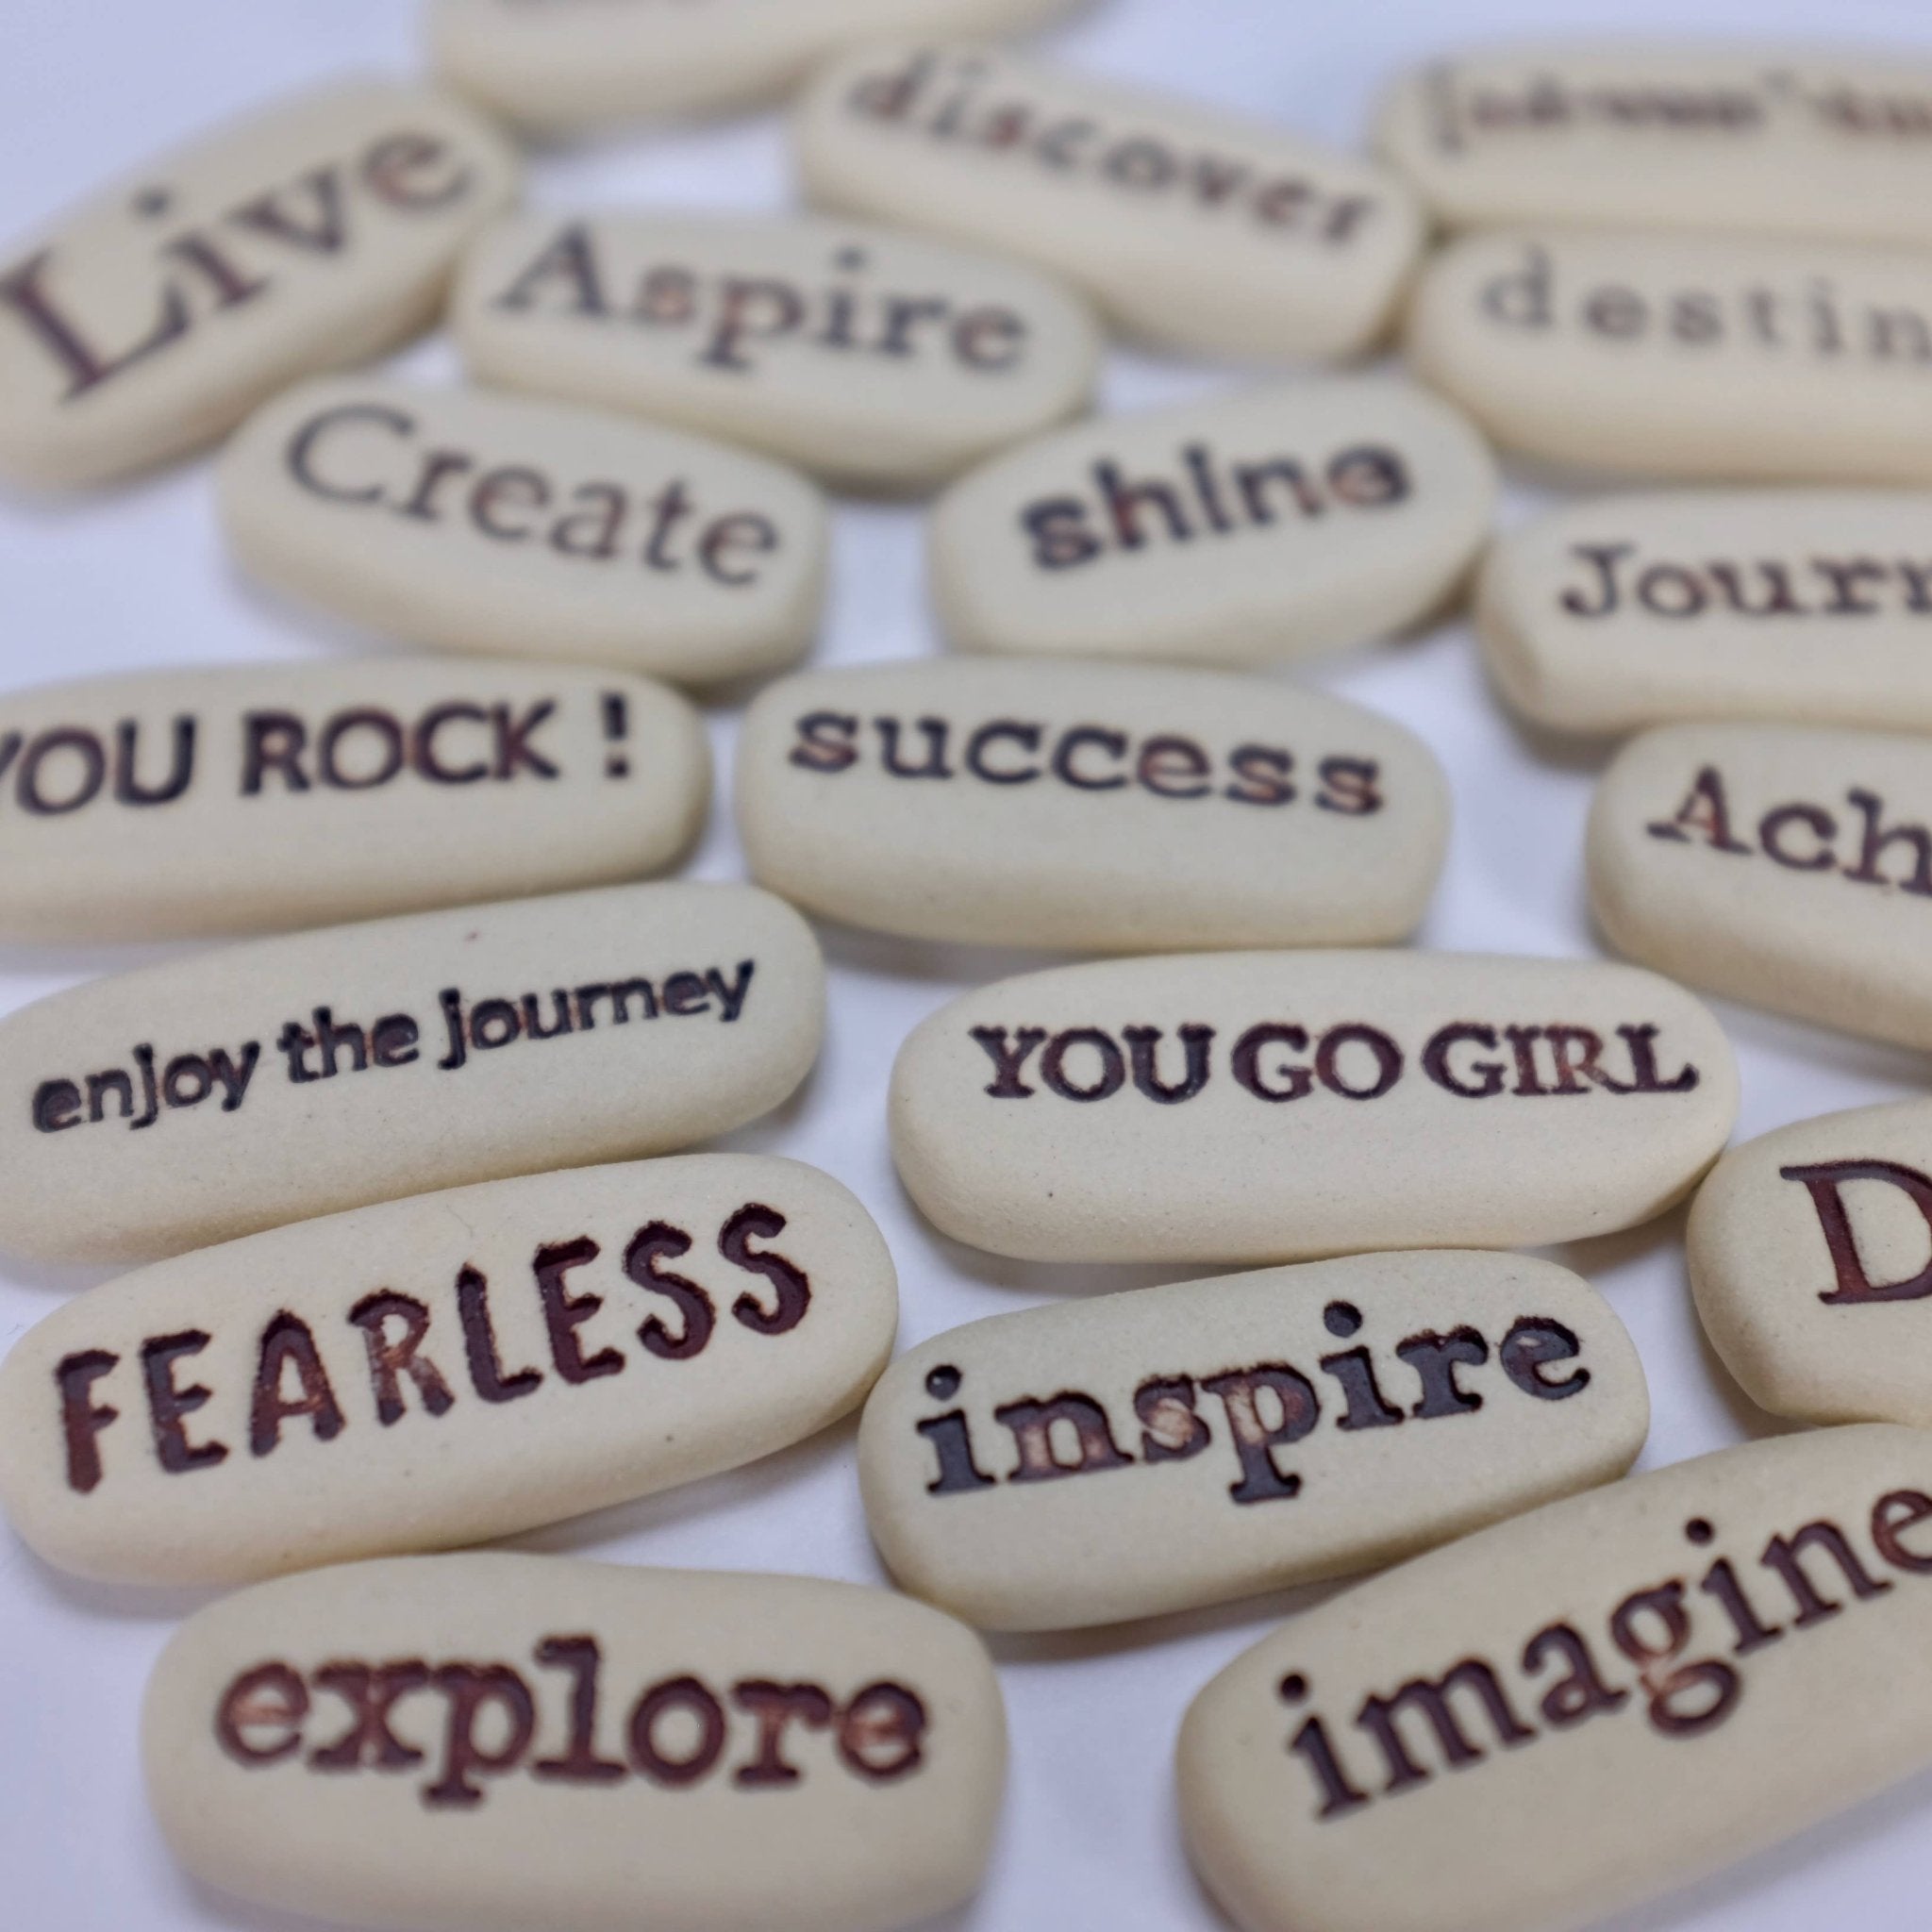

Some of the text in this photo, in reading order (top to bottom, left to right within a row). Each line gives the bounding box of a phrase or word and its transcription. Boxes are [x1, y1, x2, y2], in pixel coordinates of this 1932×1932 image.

[844, 45, 1374, 247] discover
[0, 130, 474, 406] Live
[491, 217, 1028, 374] Aspire
[284, 402, 781, 588] Create
[1021, 440, 1415, 572] shine
[238, 697, 559, 796] ROCK
[788, 709, 1383, 816] success
[1645, 762, 1932, 898] Ach
[31, 958, 755, 1133] enjoy the journey
[968, 1021, 1699, 1104] YOU GO GIRL
[53, 1202, 813, 1494] FEARLESS
[917, 1300, 1591, 1506] inspire
[213, 1634, 928, 1808] explore
[1276, 1488, 1932, 1823] imagine
